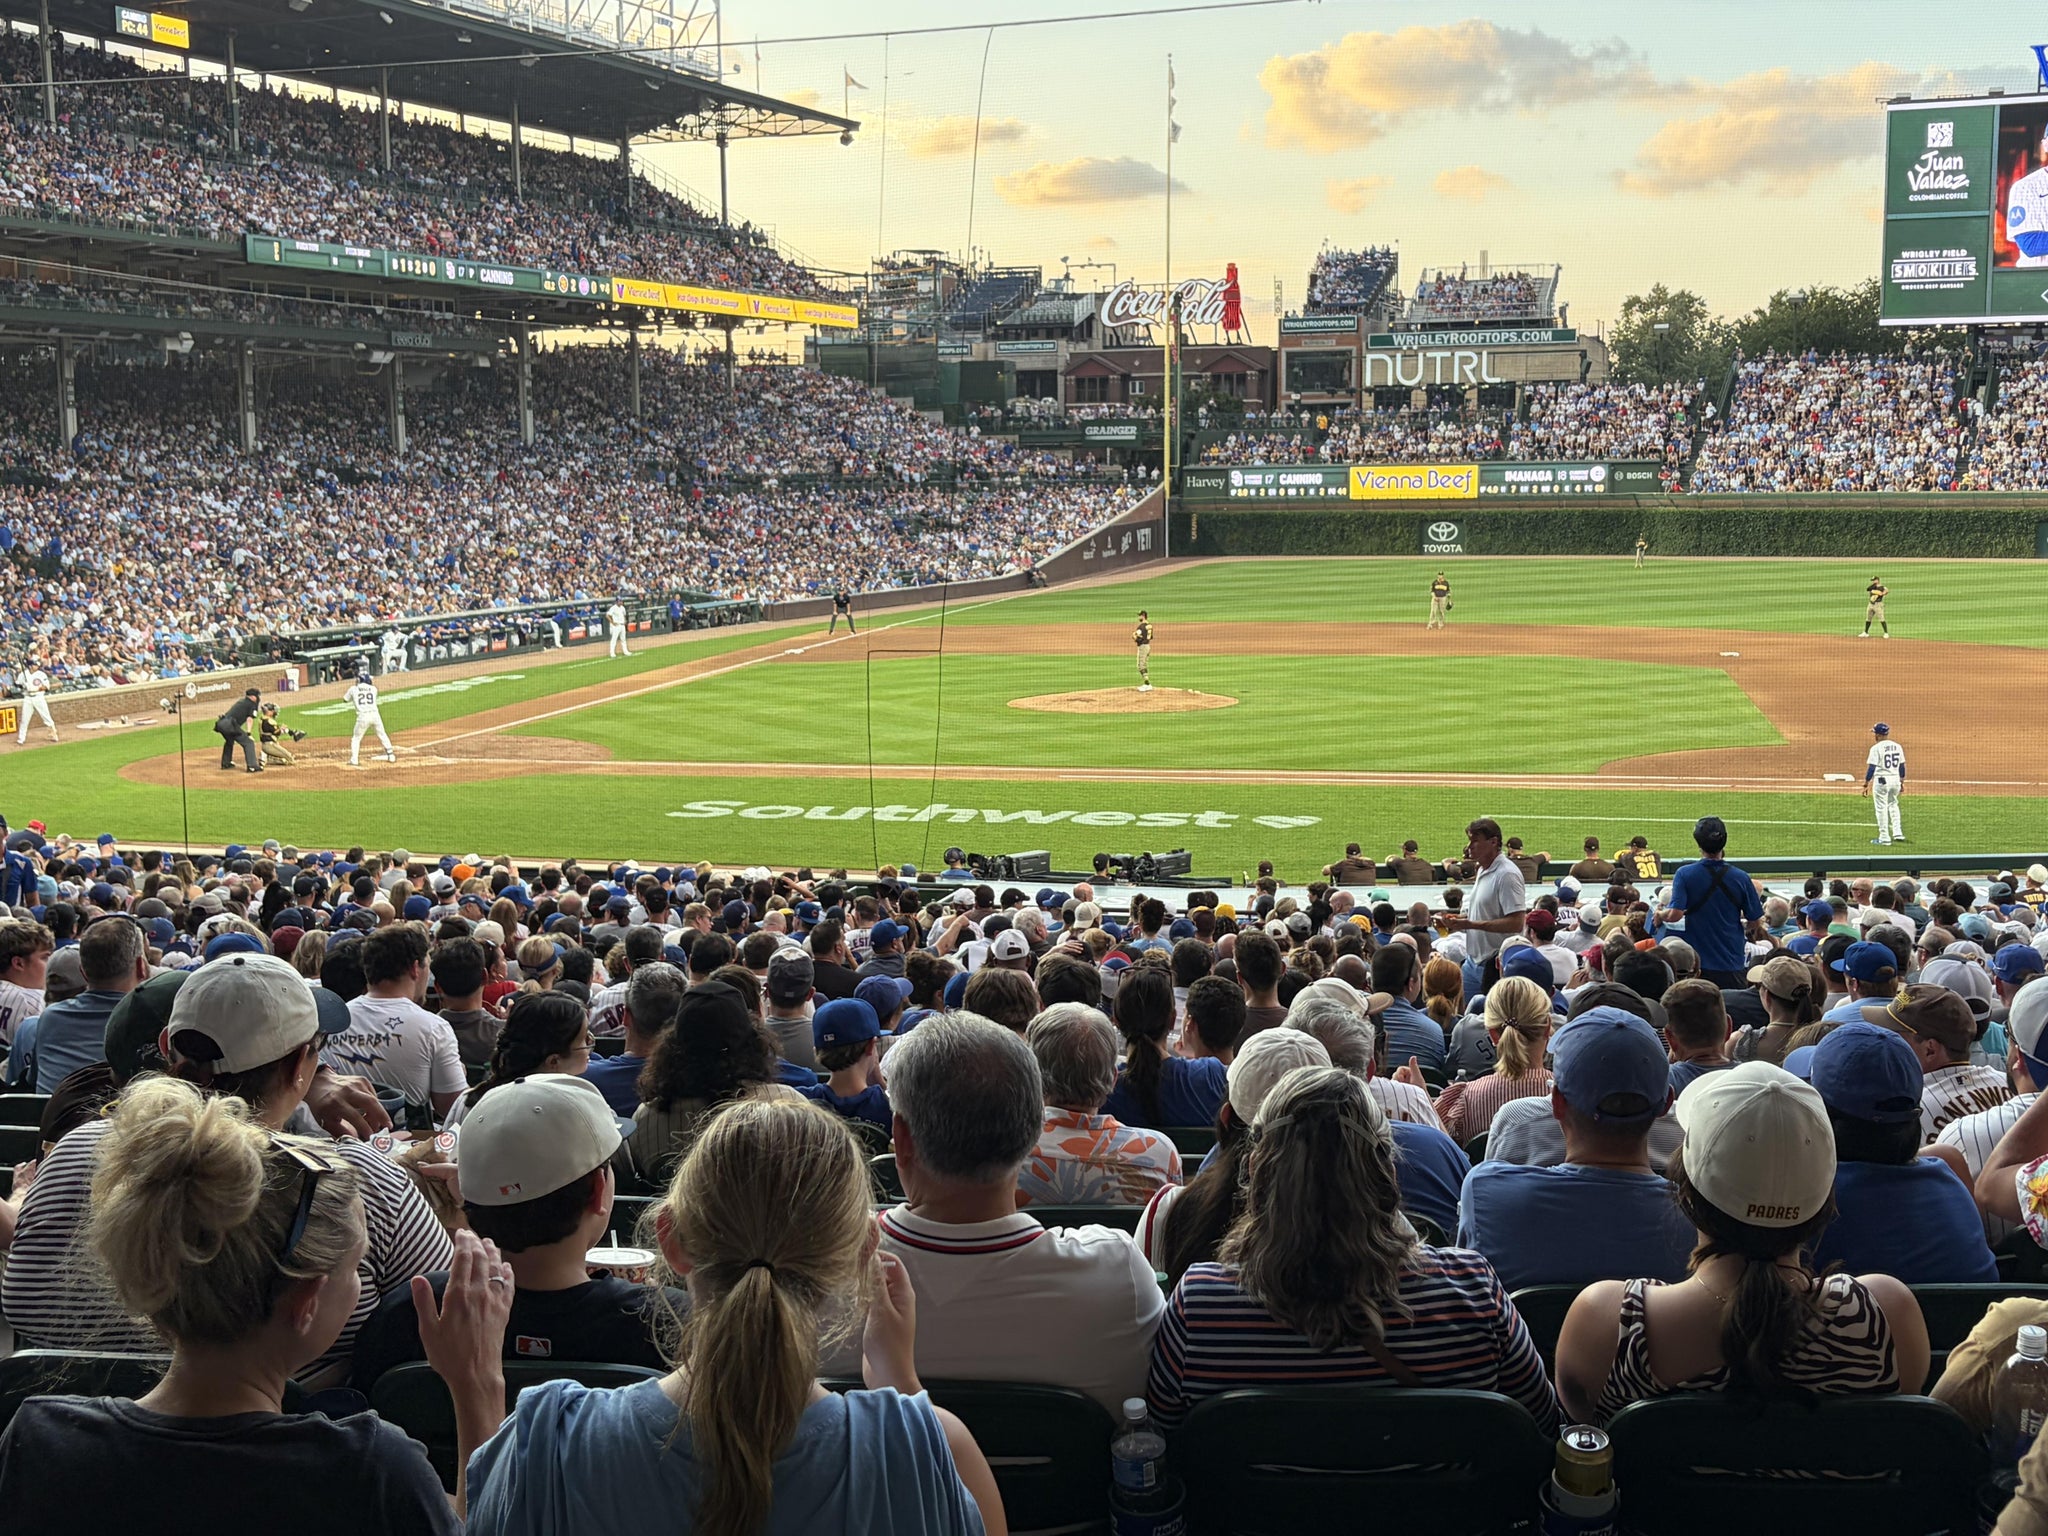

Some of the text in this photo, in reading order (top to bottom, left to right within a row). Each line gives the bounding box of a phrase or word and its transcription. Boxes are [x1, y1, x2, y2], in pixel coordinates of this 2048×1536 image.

[1914, 150, 1963, 173] Juan
[1907, 170, 1970, 191] Valdez
[1902, 249, 1967, 258] WRIGLEY FIELD
[414, 259, 421, 274] 2
[1893, 262, 1977, 278] SMOKIES
[480, 268, 514, 285] CANNING
[1392, 331, 1552, 346] WRIGLEYROOFTOPS.COM
[1085, 426, 1137, 435] GRAINGER
[1187, 476, 1225, 490] Harvey
[1265, 474, 1274, 484] 17
[1279, 473, 1323, 485] CANNING
[1356, 469, 1473, 493] Vienna Beef
[1626, 471, 1652, 480] BOSCH
[1423, 544, 1462, 553] TOYOTA
[358, 693, 374, 705] 29
[1884, 753, 1900, 769] 65
[667, 800, 1239, 829] Southwest
[1636, 862, 1658, 878] 30
[1747, 1204, 1800, 1220] PADRES
